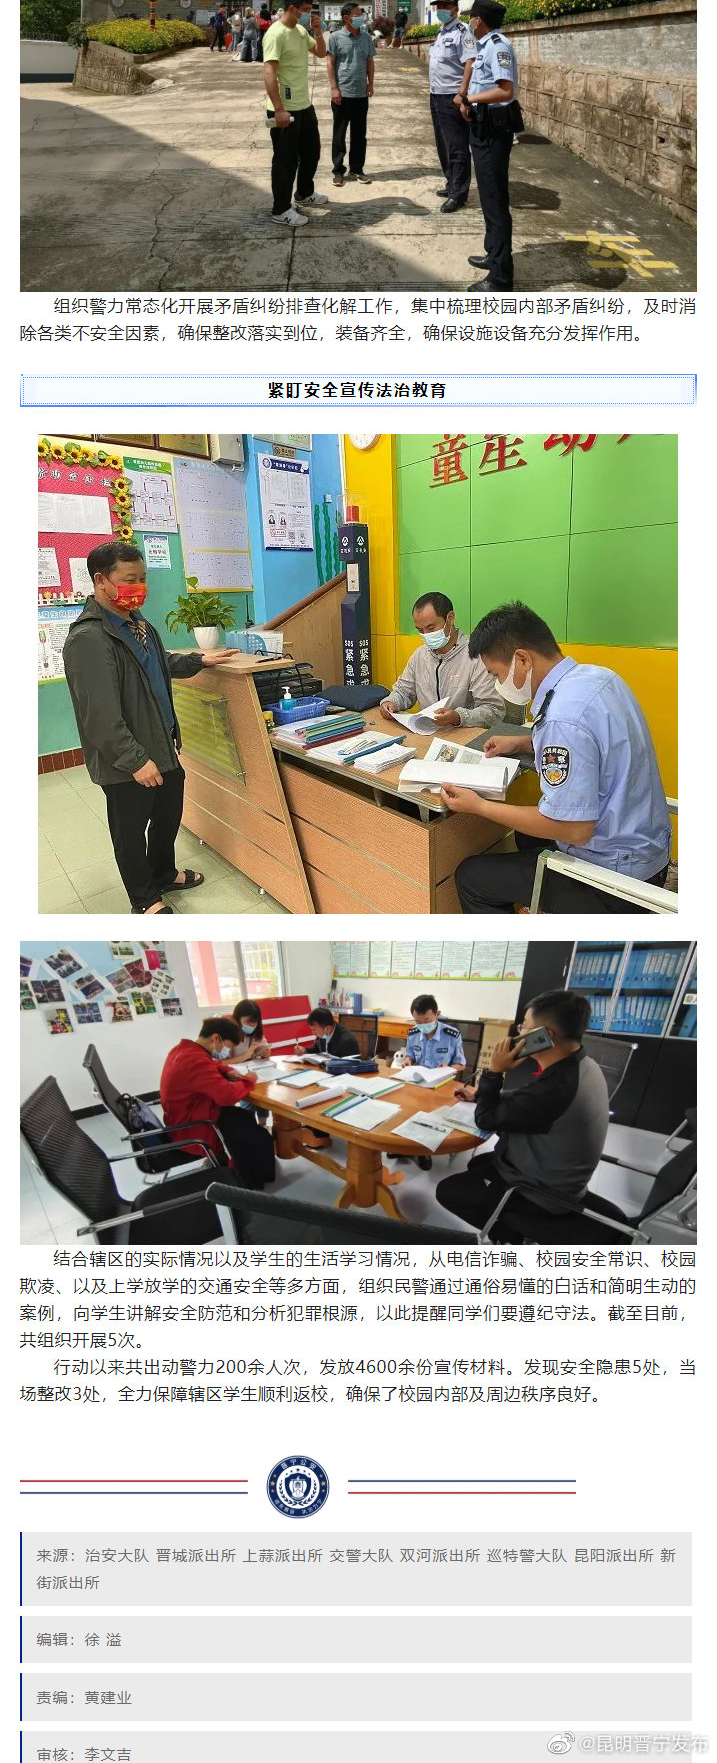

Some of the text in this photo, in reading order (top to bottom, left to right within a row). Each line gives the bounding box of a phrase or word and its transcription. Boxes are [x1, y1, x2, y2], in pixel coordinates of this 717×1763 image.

[53, 296, 697, 316] 组织警力常态化开展矛盾纠纷排查化解工作，集中梳理校园内部矛盾纠纷，及时消
[20, 323, 641, 343] 除各类不安全因素，确保整改落实到位，装备齐全，确保设施设备充分发挥作用。
[268, 381, 446, 399] 紧盯安全宣传法治教育
[53, 1249, 697, 1269] 结合辖区的实际情况以及学生的生活学习情况，从电信诈骗、校园安全常识、校园
[19, 1276, 697, 1296] 欺凌、以及上学放学的交通安全等多方面，组织民警通过通俗易懂的白话和简明生动的
[19, 1303, 686, 1323] 案例，向学生讲解安全防范和分析犯罪根源，以此提醒同学们要遵纪守法。截至目前，
[19, 1331, 142, 1349] 共组织开展5次。
[53, 1358, 697, 1377] 行动以来共出动警力200余人次，发放4600余份宣传材料。发现安全隐患5处，当
[19, 1384, 598, 1404] 场整改3处，全力保障辖区学生顺利返校，确保了校园内部及周边秩序良好。
[155, 1547, 237, 1563] 晋城派出所
[242, 1547, 322, 1563] 上蒜派出所
[329, 1547, 393, 1563] 交警大队
[400, 1547, 481, 1563] 双河派出所
[486, 1547, 567, 1563] 巡特警大队
[574, 1547, 654, 1563] 昆阳派出所
[660, 1547, 676, 1563] 新
[36, 1575, 100, 1590] 街派出所
[36, 1690, 132, 1705] 责编：黄建业
[36, 1746, 132, 1762] 审核：李文吉
